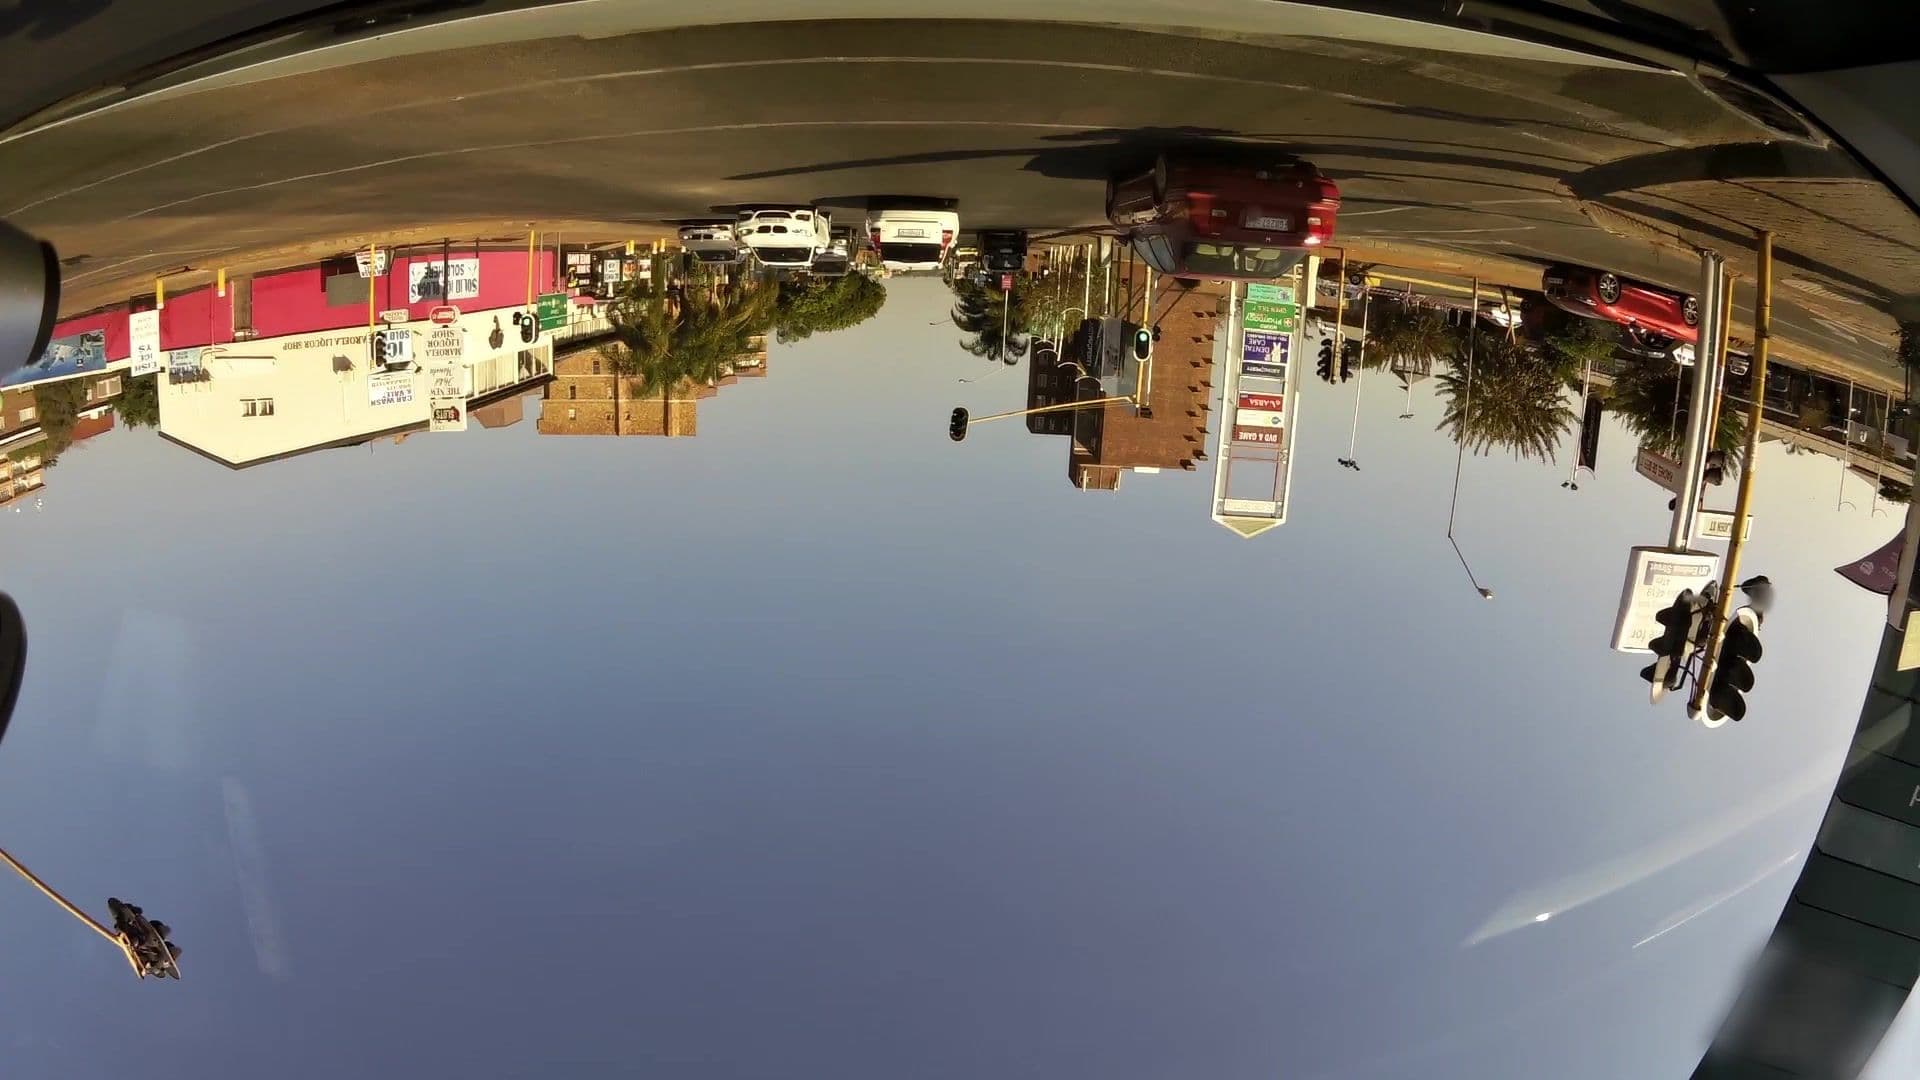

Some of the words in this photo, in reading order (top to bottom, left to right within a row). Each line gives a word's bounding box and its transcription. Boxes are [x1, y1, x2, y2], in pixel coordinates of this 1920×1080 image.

[424, 266, 444, 280] HERE
[456, 278, 477, 294] SOLID
[390, 330, 410, 340] SOLD
[432, 330, 454, 339] SHOP
[304, 338, 332, 349] LIQUOR
[334, 336, 367, 346] AROELA
[427, 338, 460, 348] LIQUOR
[1248, 338, 1266, 346] CARE
[282, 342, 302, 350] SHOP
[1244, 344, 1270, 354] DENTAL
[426, 348, 461, 358] MAROELA
[430, 388, 445, 396] NEW
[447, 388, 460, 396] THE
[370, 397, 394, 406] WASH
[396, 394, 412, 402] CAR
[1238, 432, 1257, 440] GAME
[1264, 434, 1278, 442] DVD
